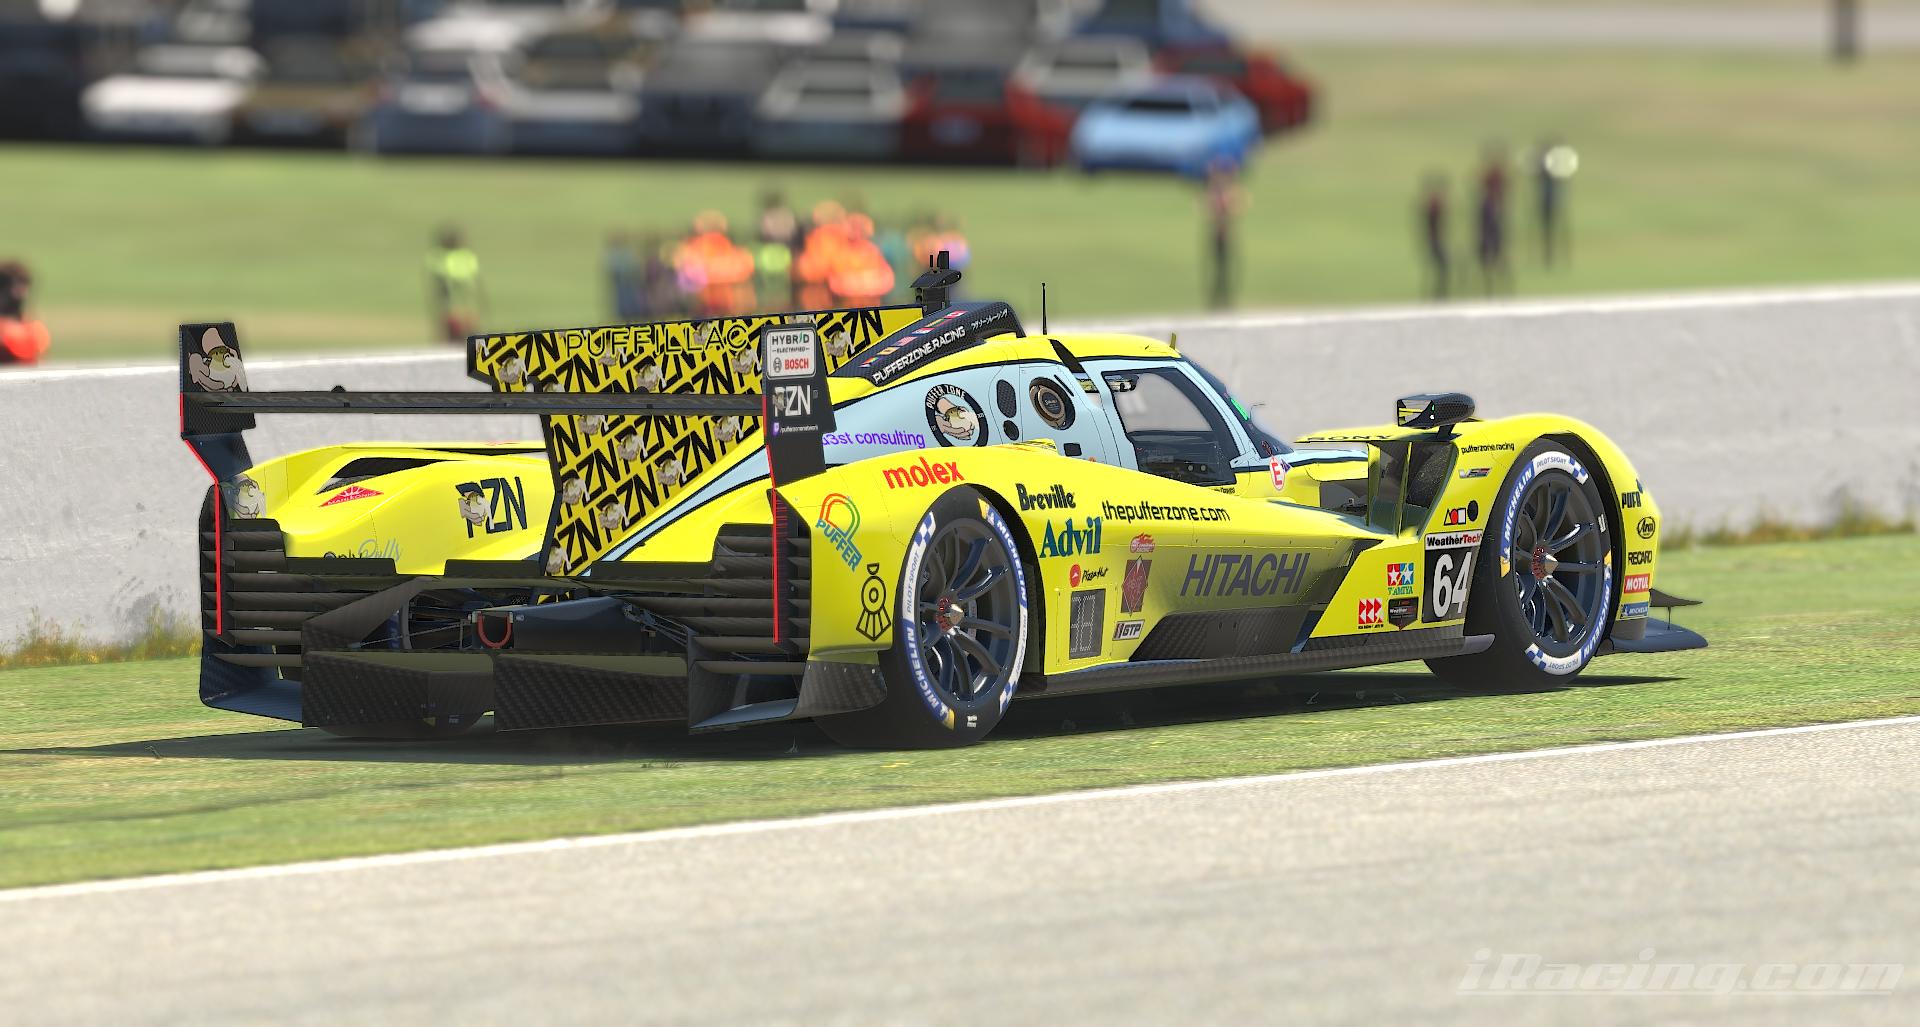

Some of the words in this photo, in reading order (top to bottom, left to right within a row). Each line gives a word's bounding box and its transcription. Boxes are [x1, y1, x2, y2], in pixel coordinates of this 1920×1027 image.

[565, 323, 748, 361] PUFFILLAC
[771, 332, 810, 346] HYBRID
[872, 326, 966, 384] PUFFERZONE.RACING
[784, 357, 809, 371] BOSCH
[945, 384, 967, 400] ZONE
[855, 429, 926, 449] consulting
[882, 456, 965, 489] molex
[1015, 483, 1076, 511] Breville
[1101, 499, 1231, 524] thepufferzone.com
[1504, 467, 1532, 542] MICHELIN
[815, 518, 862, 573] PUFFER
[1038, 516, 1102, 558] Advil
[1427, 533, 1481, 547] WeatherTech
[997, 521, 1026, 601] MICHELIN
[1180, 552, 1311, 597] HITACHI
[1432, 551, 1473, 618] 64
[1625, 577, 1649, 590] MOTUL
[1122, 623, 1142, 637] GTP
[1583, 583, 1610, 659] MICHELIN
[906, 626, 943, 711] MICHELIN
